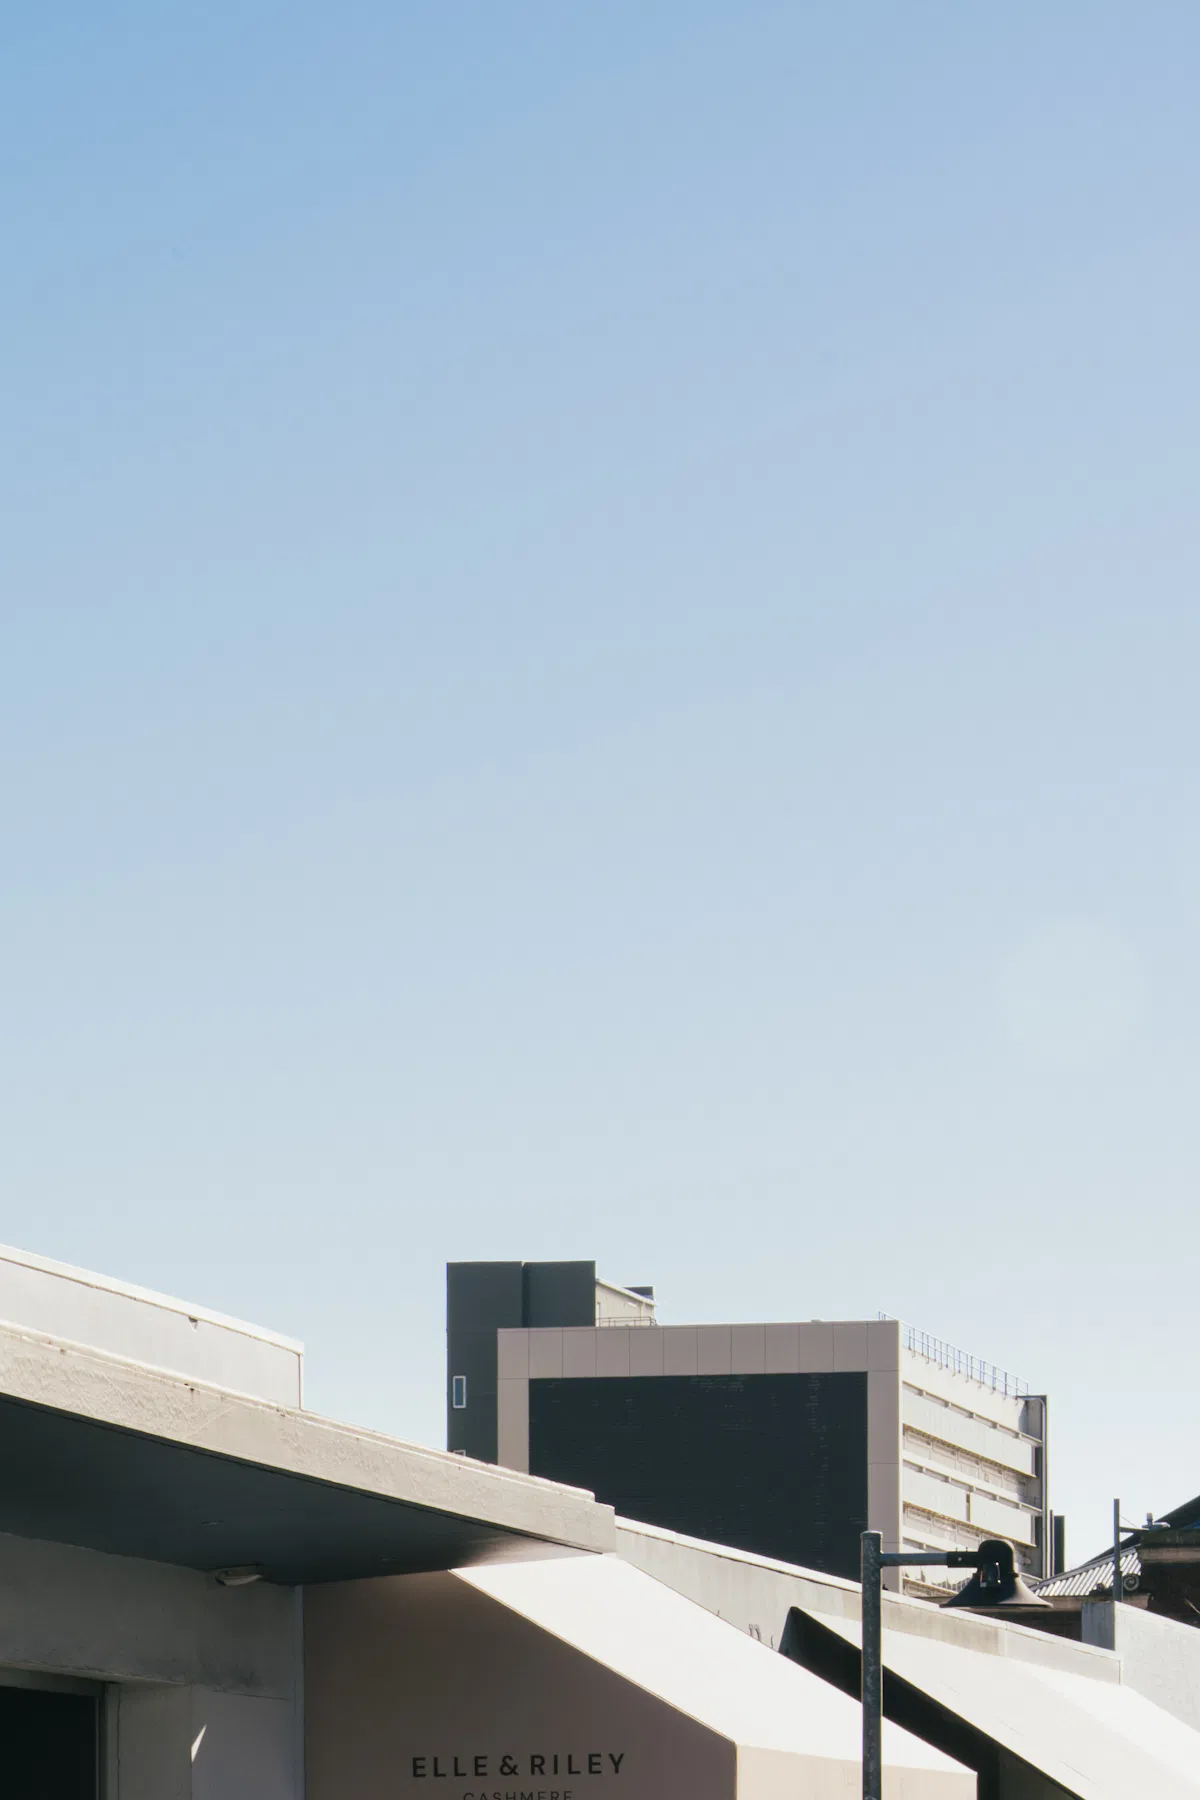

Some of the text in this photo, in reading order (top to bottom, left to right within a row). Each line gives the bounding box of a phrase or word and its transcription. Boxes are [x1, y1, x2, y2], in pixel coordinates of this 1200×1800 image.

[412, 1752, 625, 1778] ELLE & RILEY
